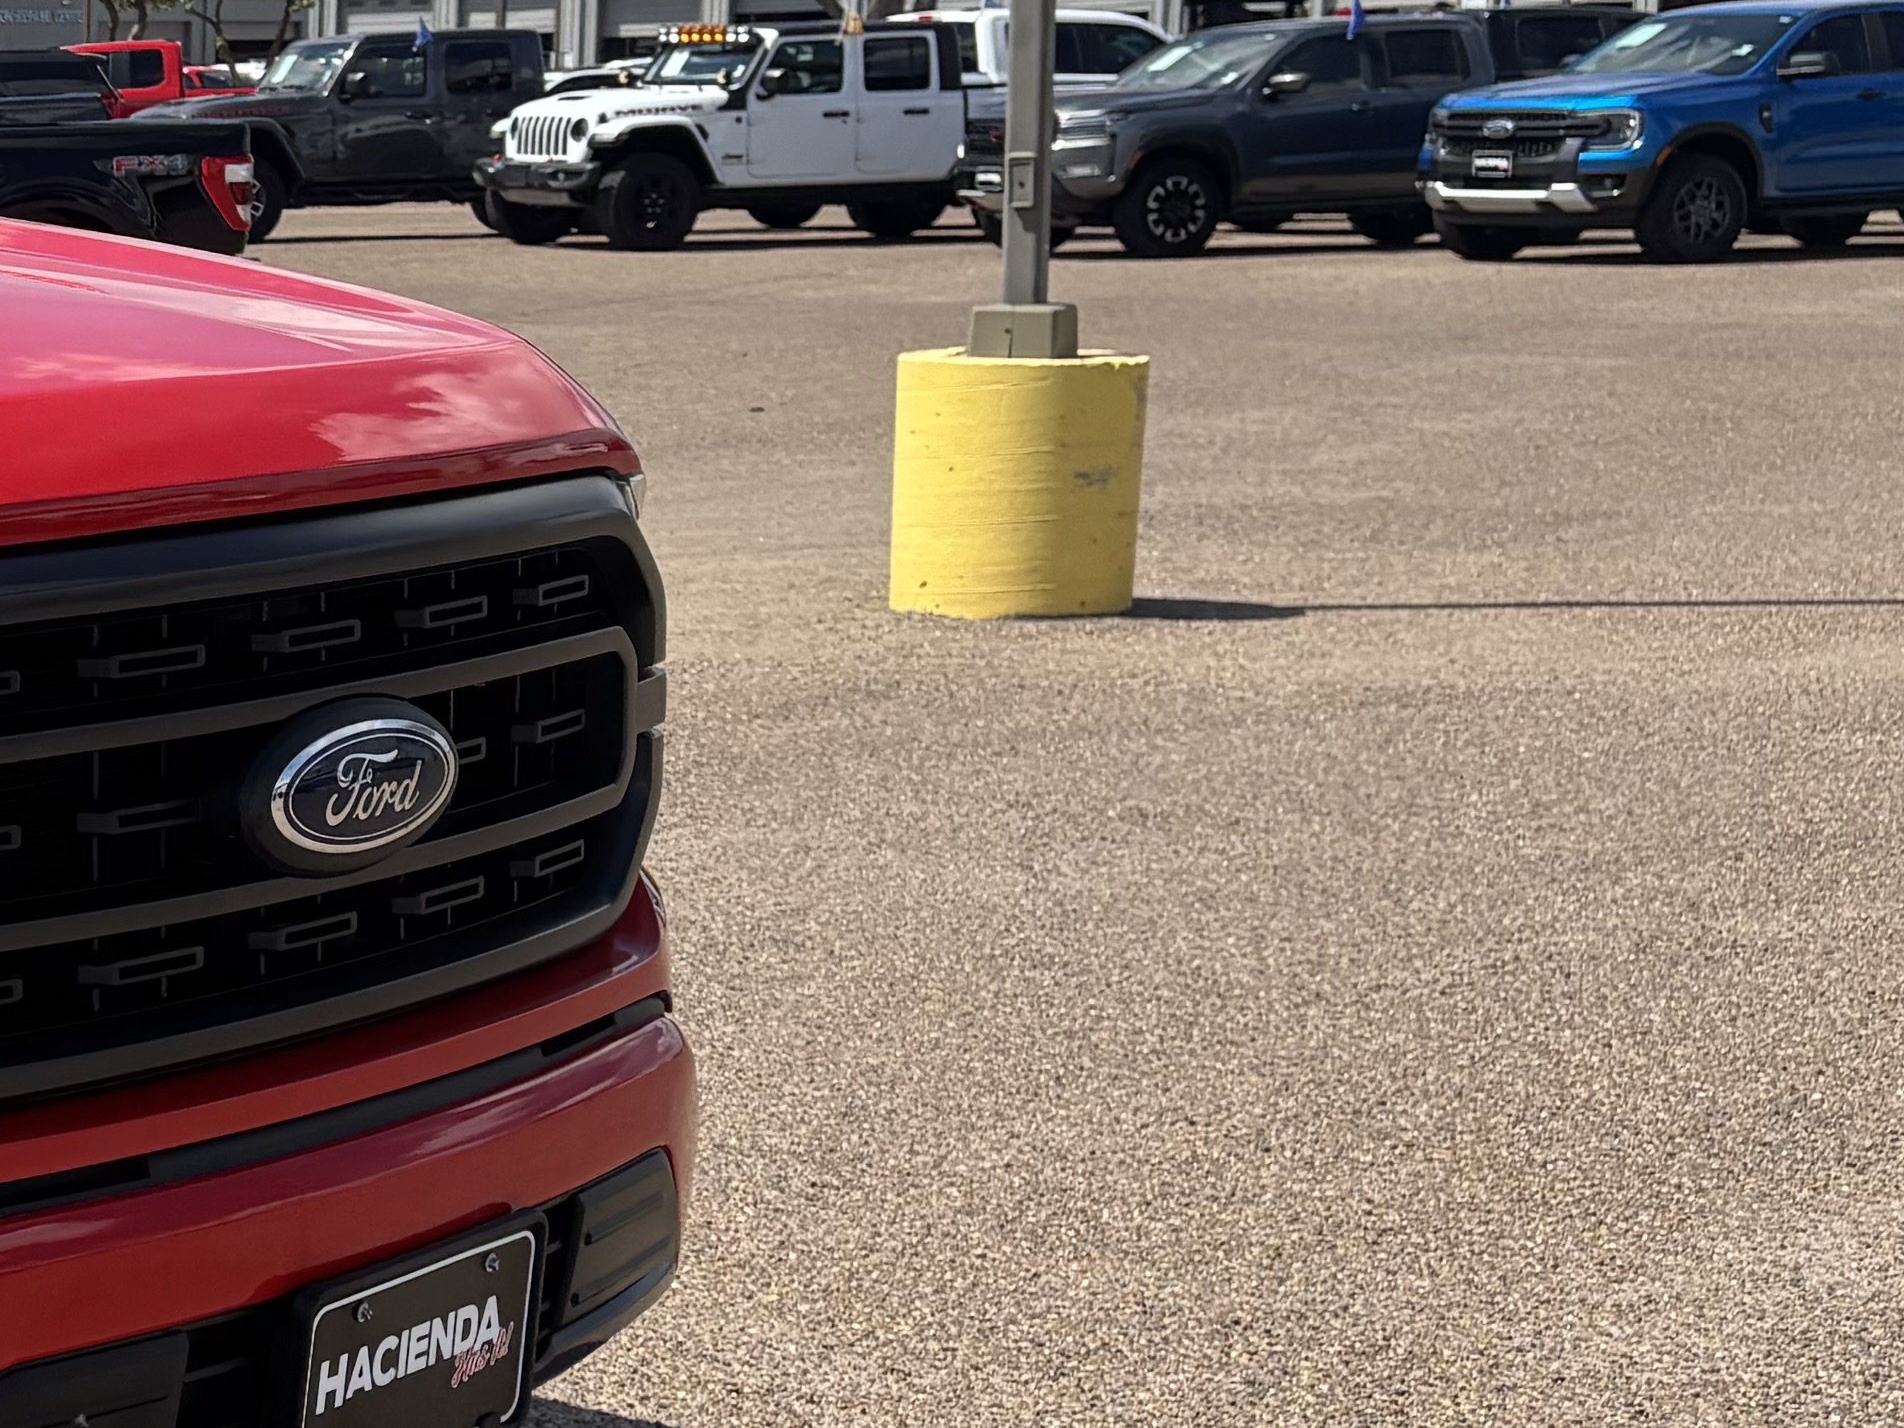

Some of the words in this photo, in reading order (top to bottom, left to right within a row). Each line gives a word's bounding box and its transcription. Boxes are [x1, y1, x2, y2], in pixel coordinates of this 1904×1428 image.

[113, 154, 188, 177] FX4
[325, 749, 423, 826] Ford
[315, 1295, 500, 1415] HACIENDA
